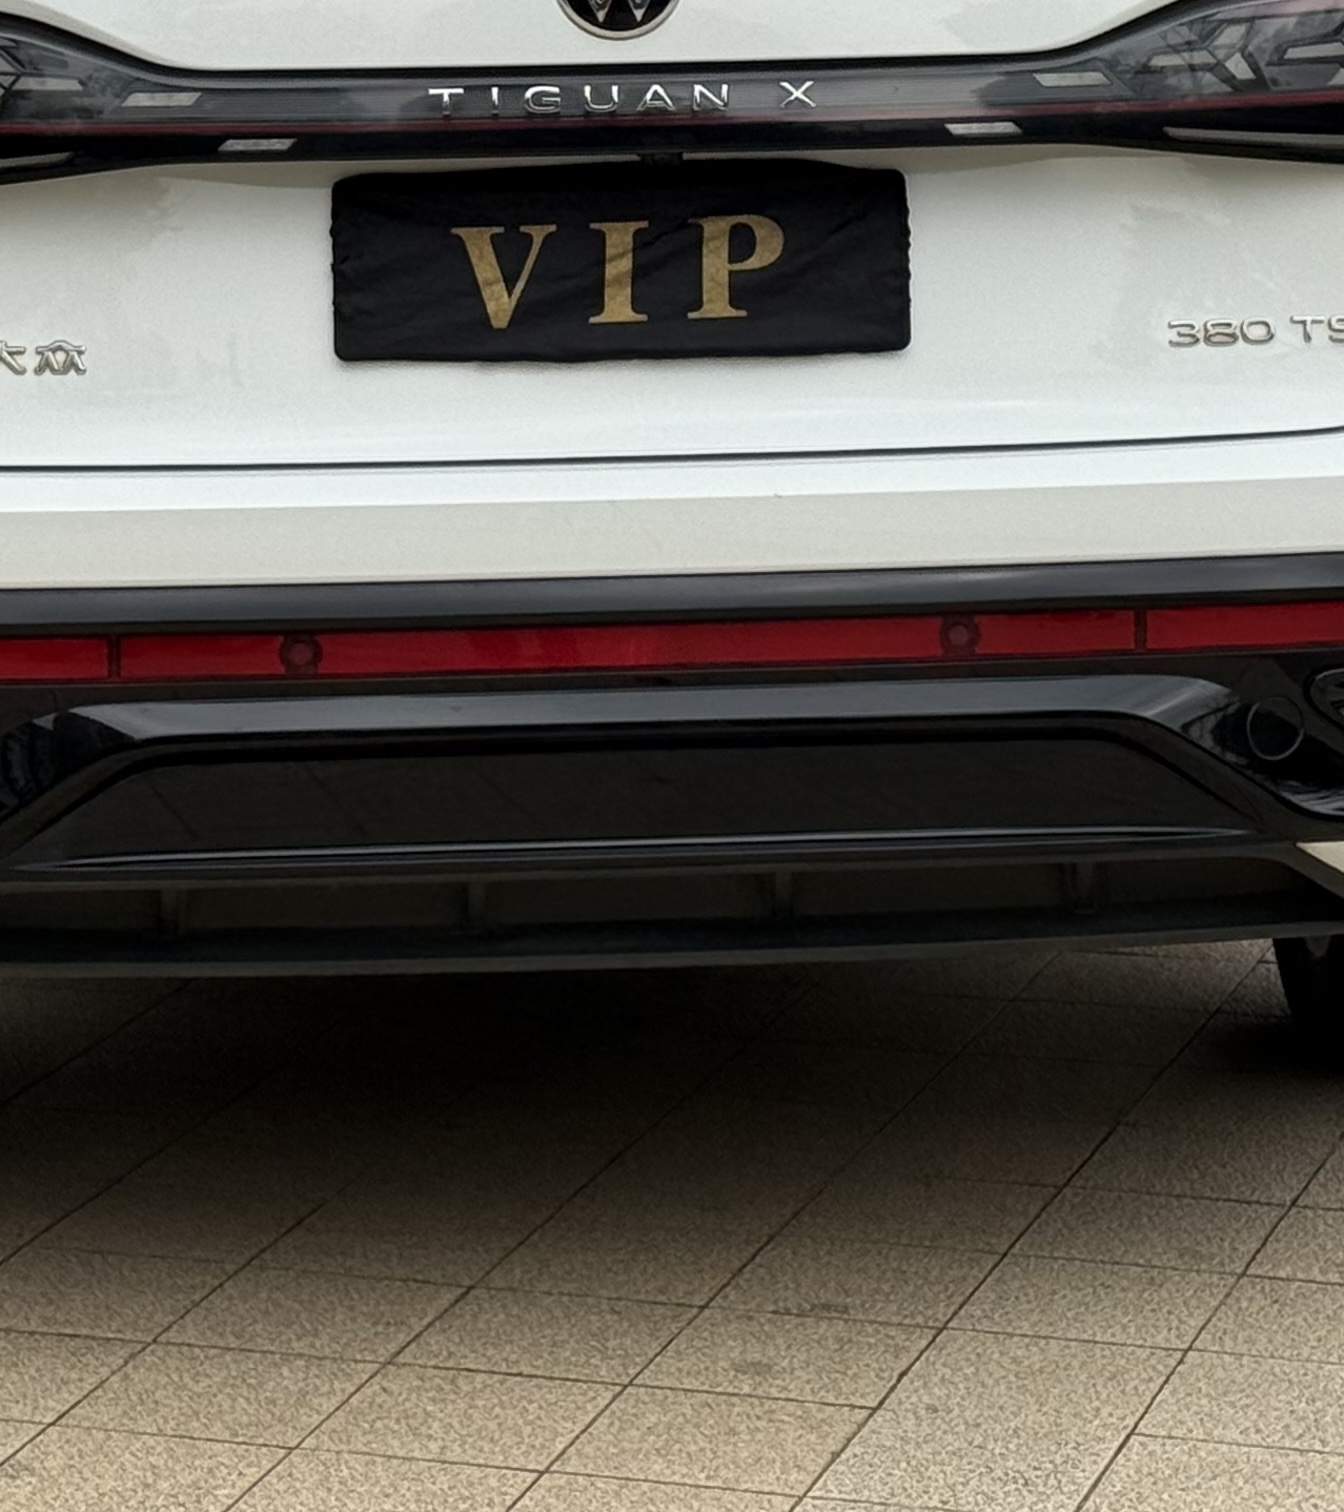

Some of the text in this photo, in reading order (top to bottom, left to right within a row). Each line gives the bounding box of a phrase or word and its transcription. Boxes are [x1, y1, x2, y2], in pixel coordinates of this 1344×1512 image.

[428, 80, 817, 116] TIGUAN X
[450, 214, 786, 330] VIP
[1167, 318, 1275, 347] 380
